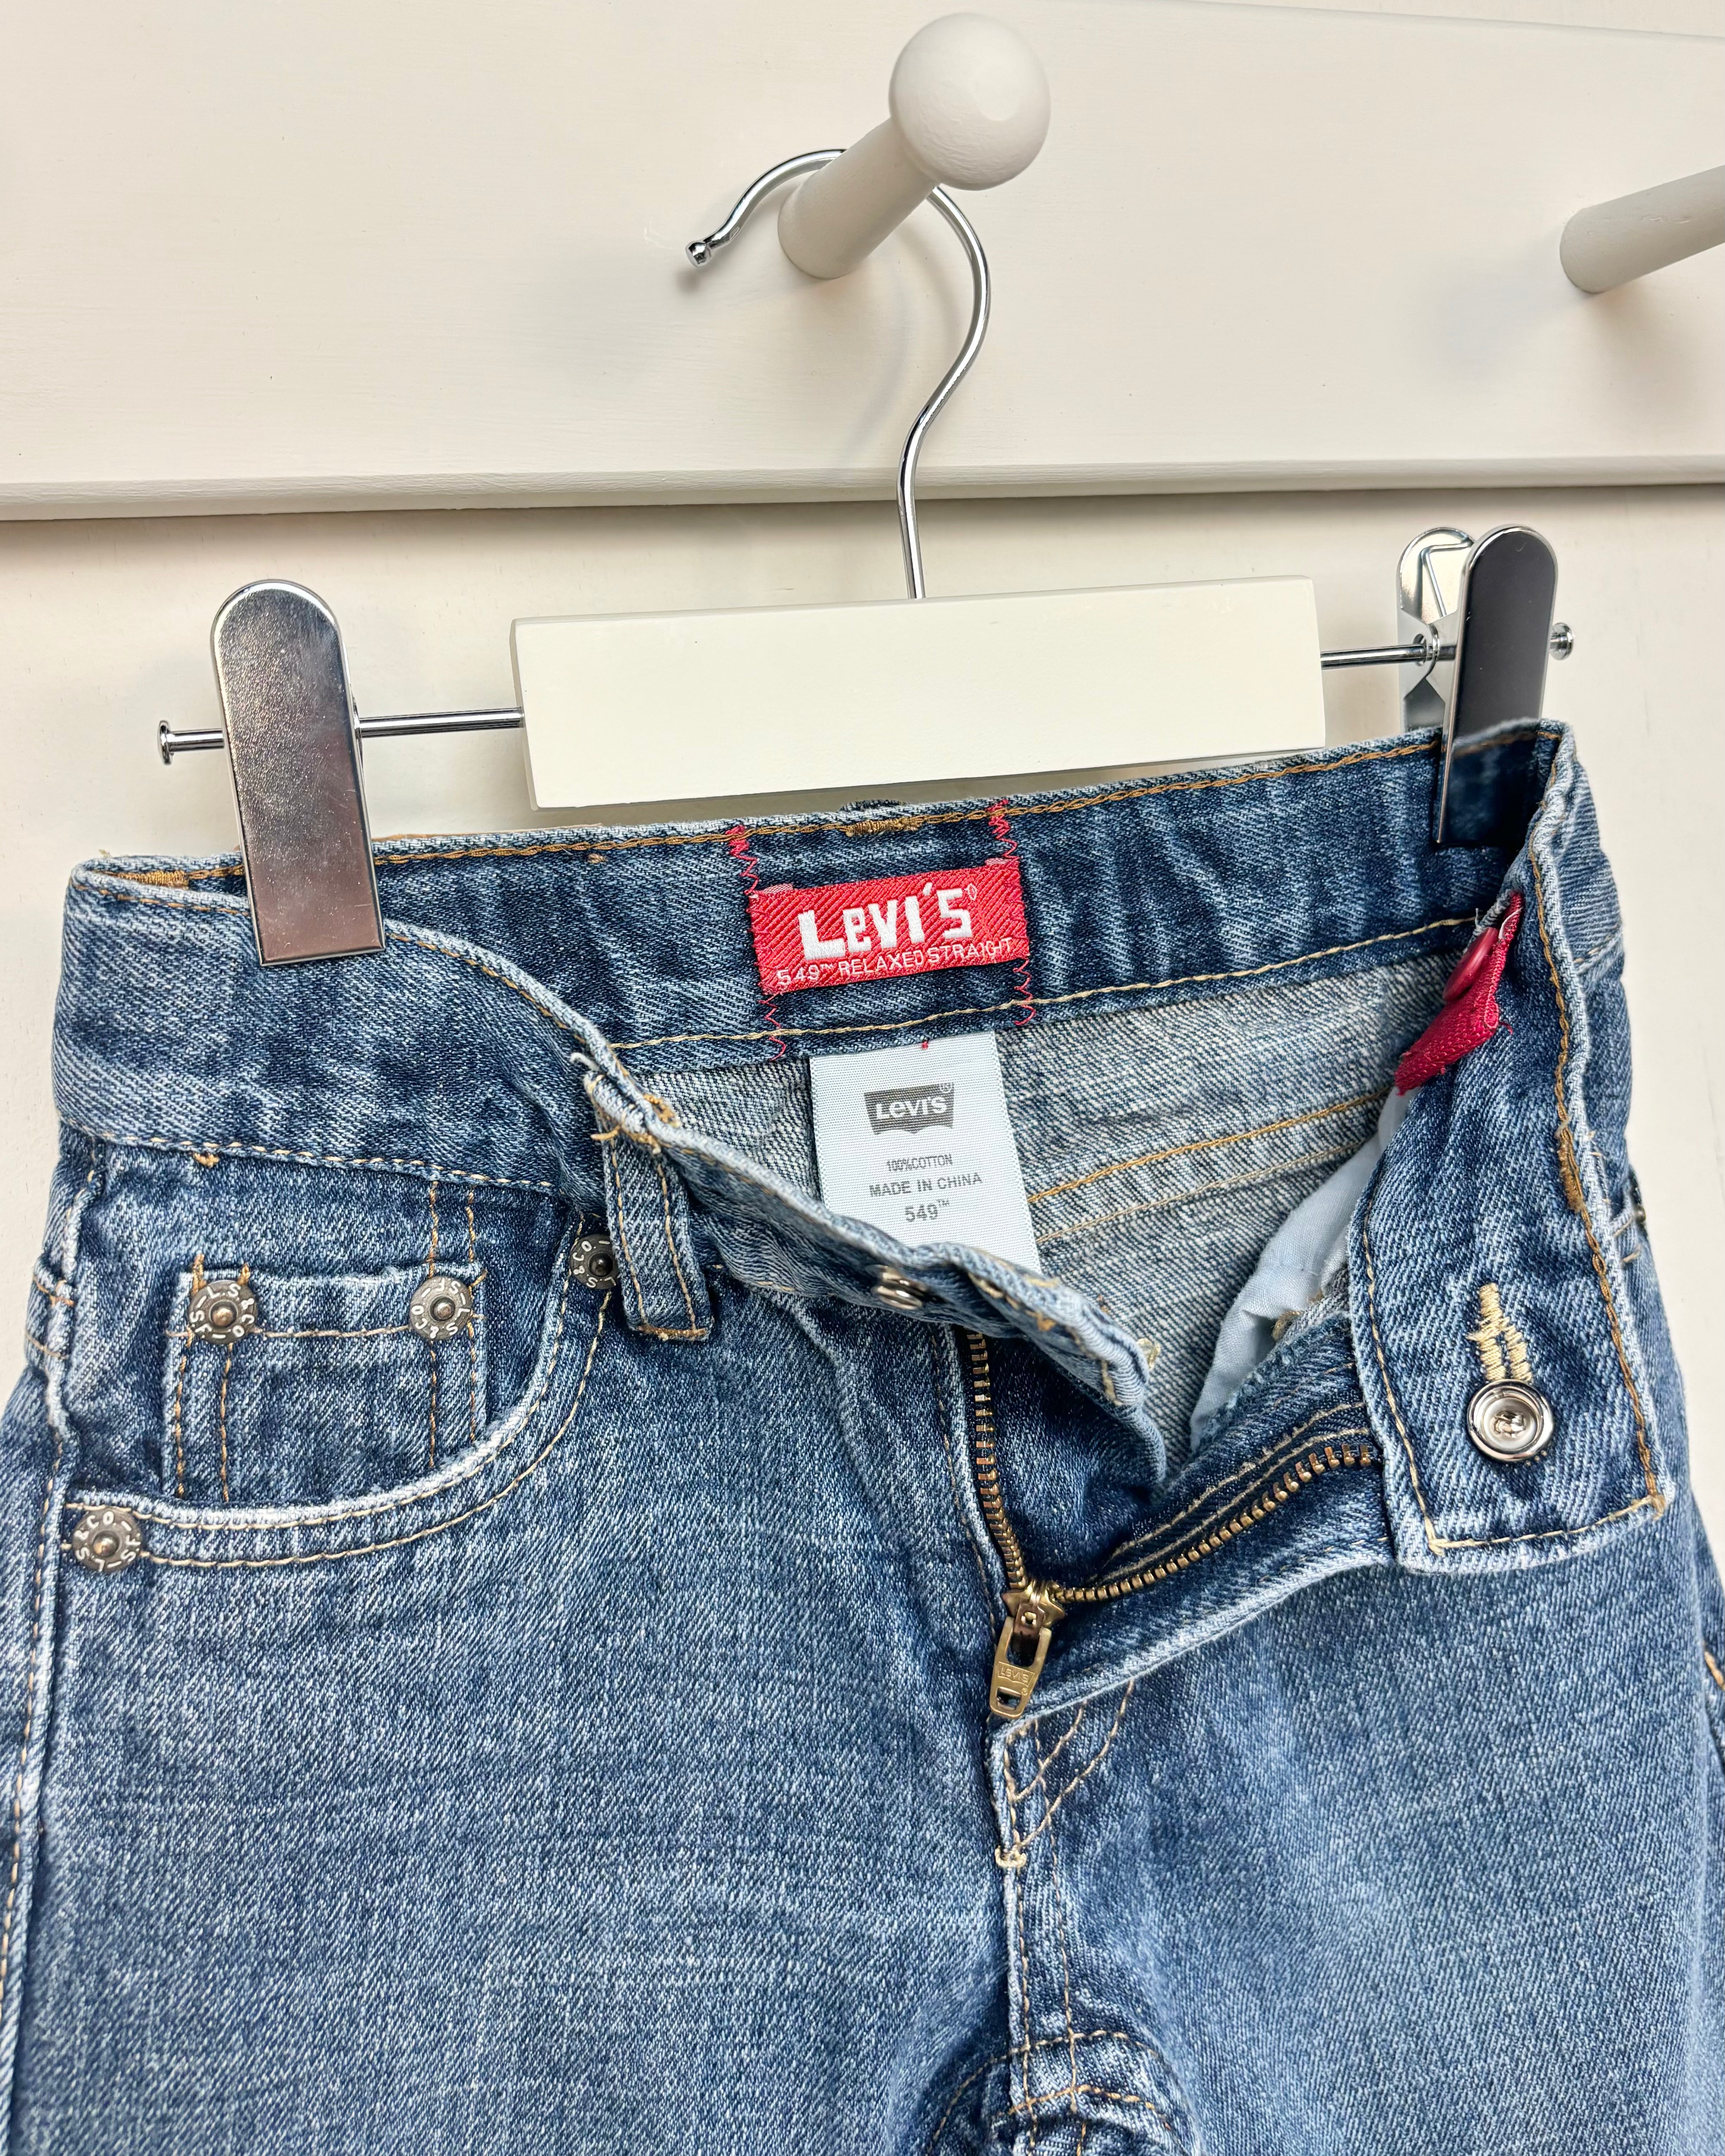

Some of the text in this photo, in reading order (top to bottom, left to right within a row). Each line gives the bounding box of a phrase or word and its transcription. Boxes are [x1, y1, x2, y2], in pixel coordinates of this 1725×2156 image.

[838, 949, 924, 976] RELAXED
[927, 937, 1012, 963] STRAIGHT
[869, 1172, 983, 1197] MADE IN CHINA
